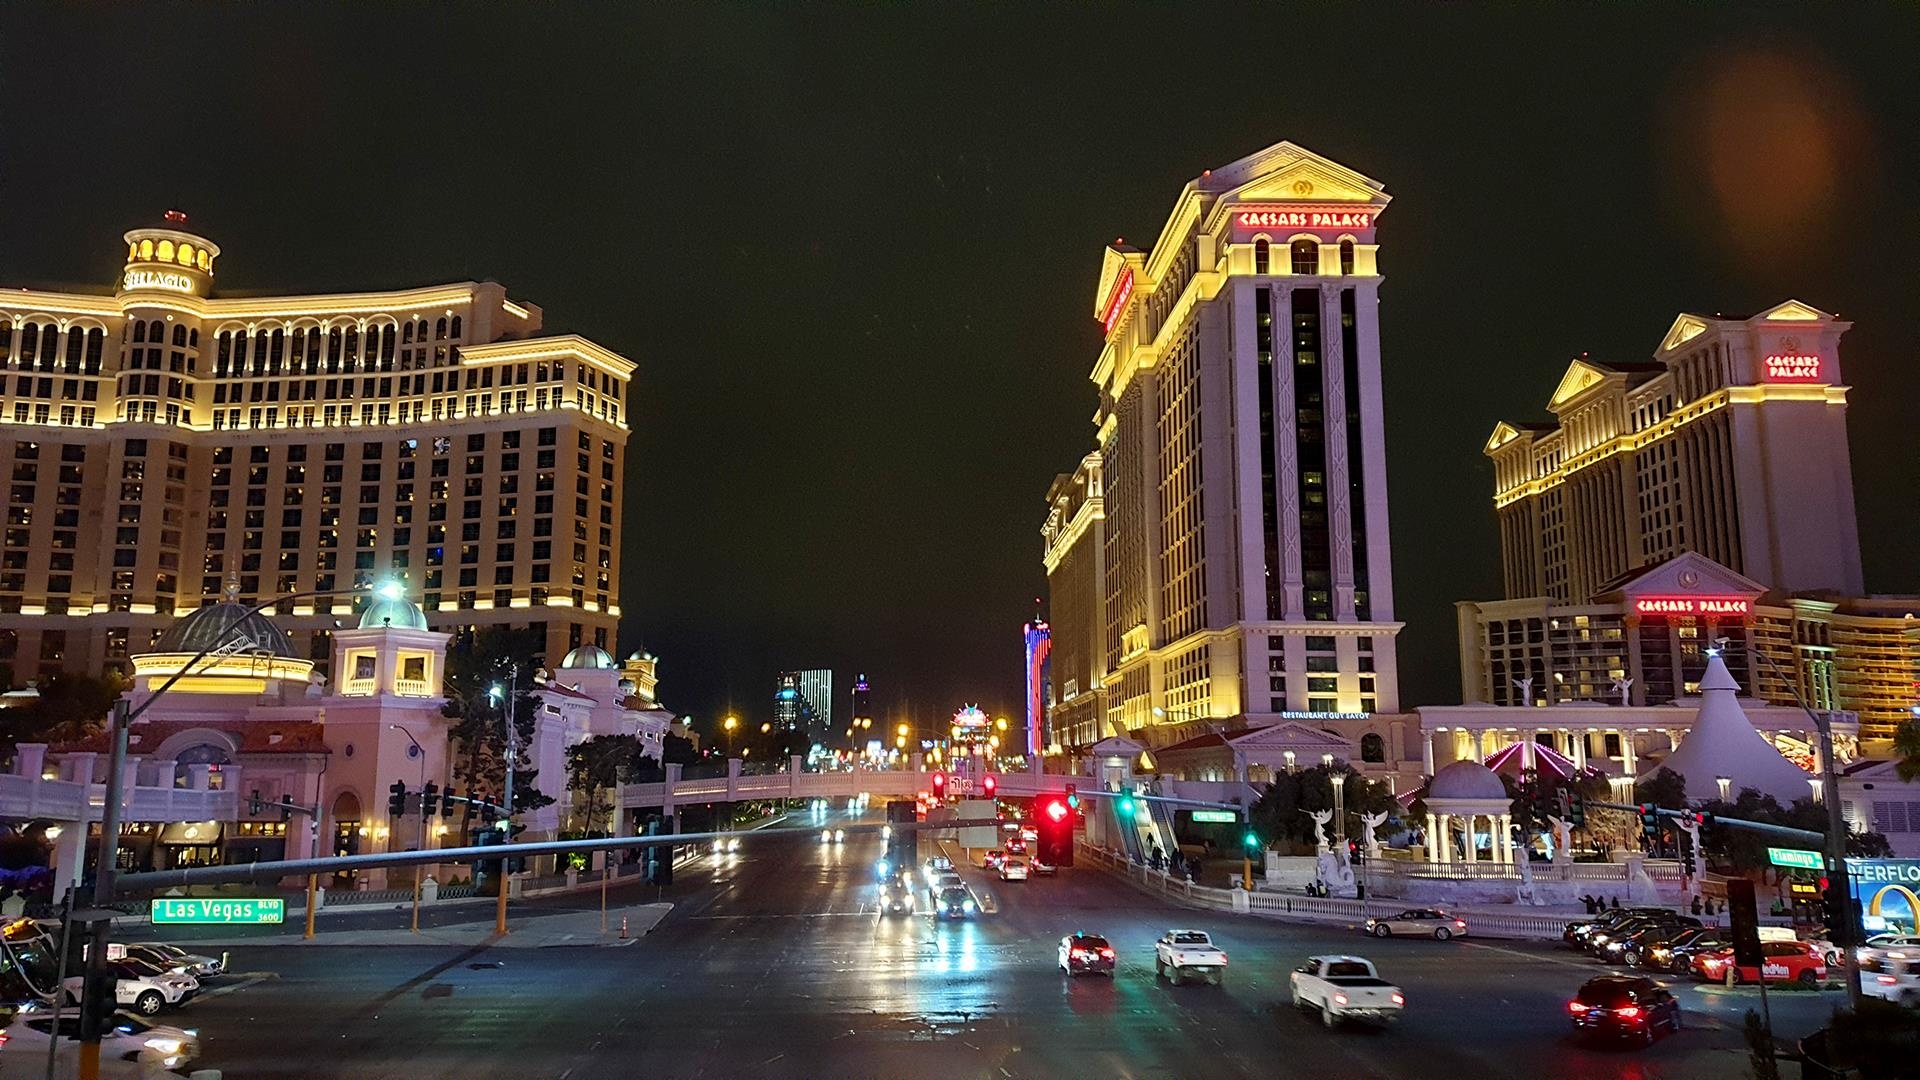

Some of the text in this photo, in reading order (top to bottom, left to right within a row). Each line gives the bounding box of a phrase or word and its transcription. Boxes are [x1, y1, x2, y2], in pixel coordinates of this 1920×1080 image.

[1239, 213, 1369, 227] CAESARS PALACE
[1766, 356, 1819, 367] CAESARS
[1769, 367, 1818, 377] PALACE
[1637, 600, 1747, 612] CAESARS PALACE
[1282, 711, 1327, 719] RESTAURANT
[165, 900, 196, 918] Las
[201, 900, 252, 922] Vegas
[257, 900, 279, 910] BLVD
[257, 913, 279, 922] 3600
